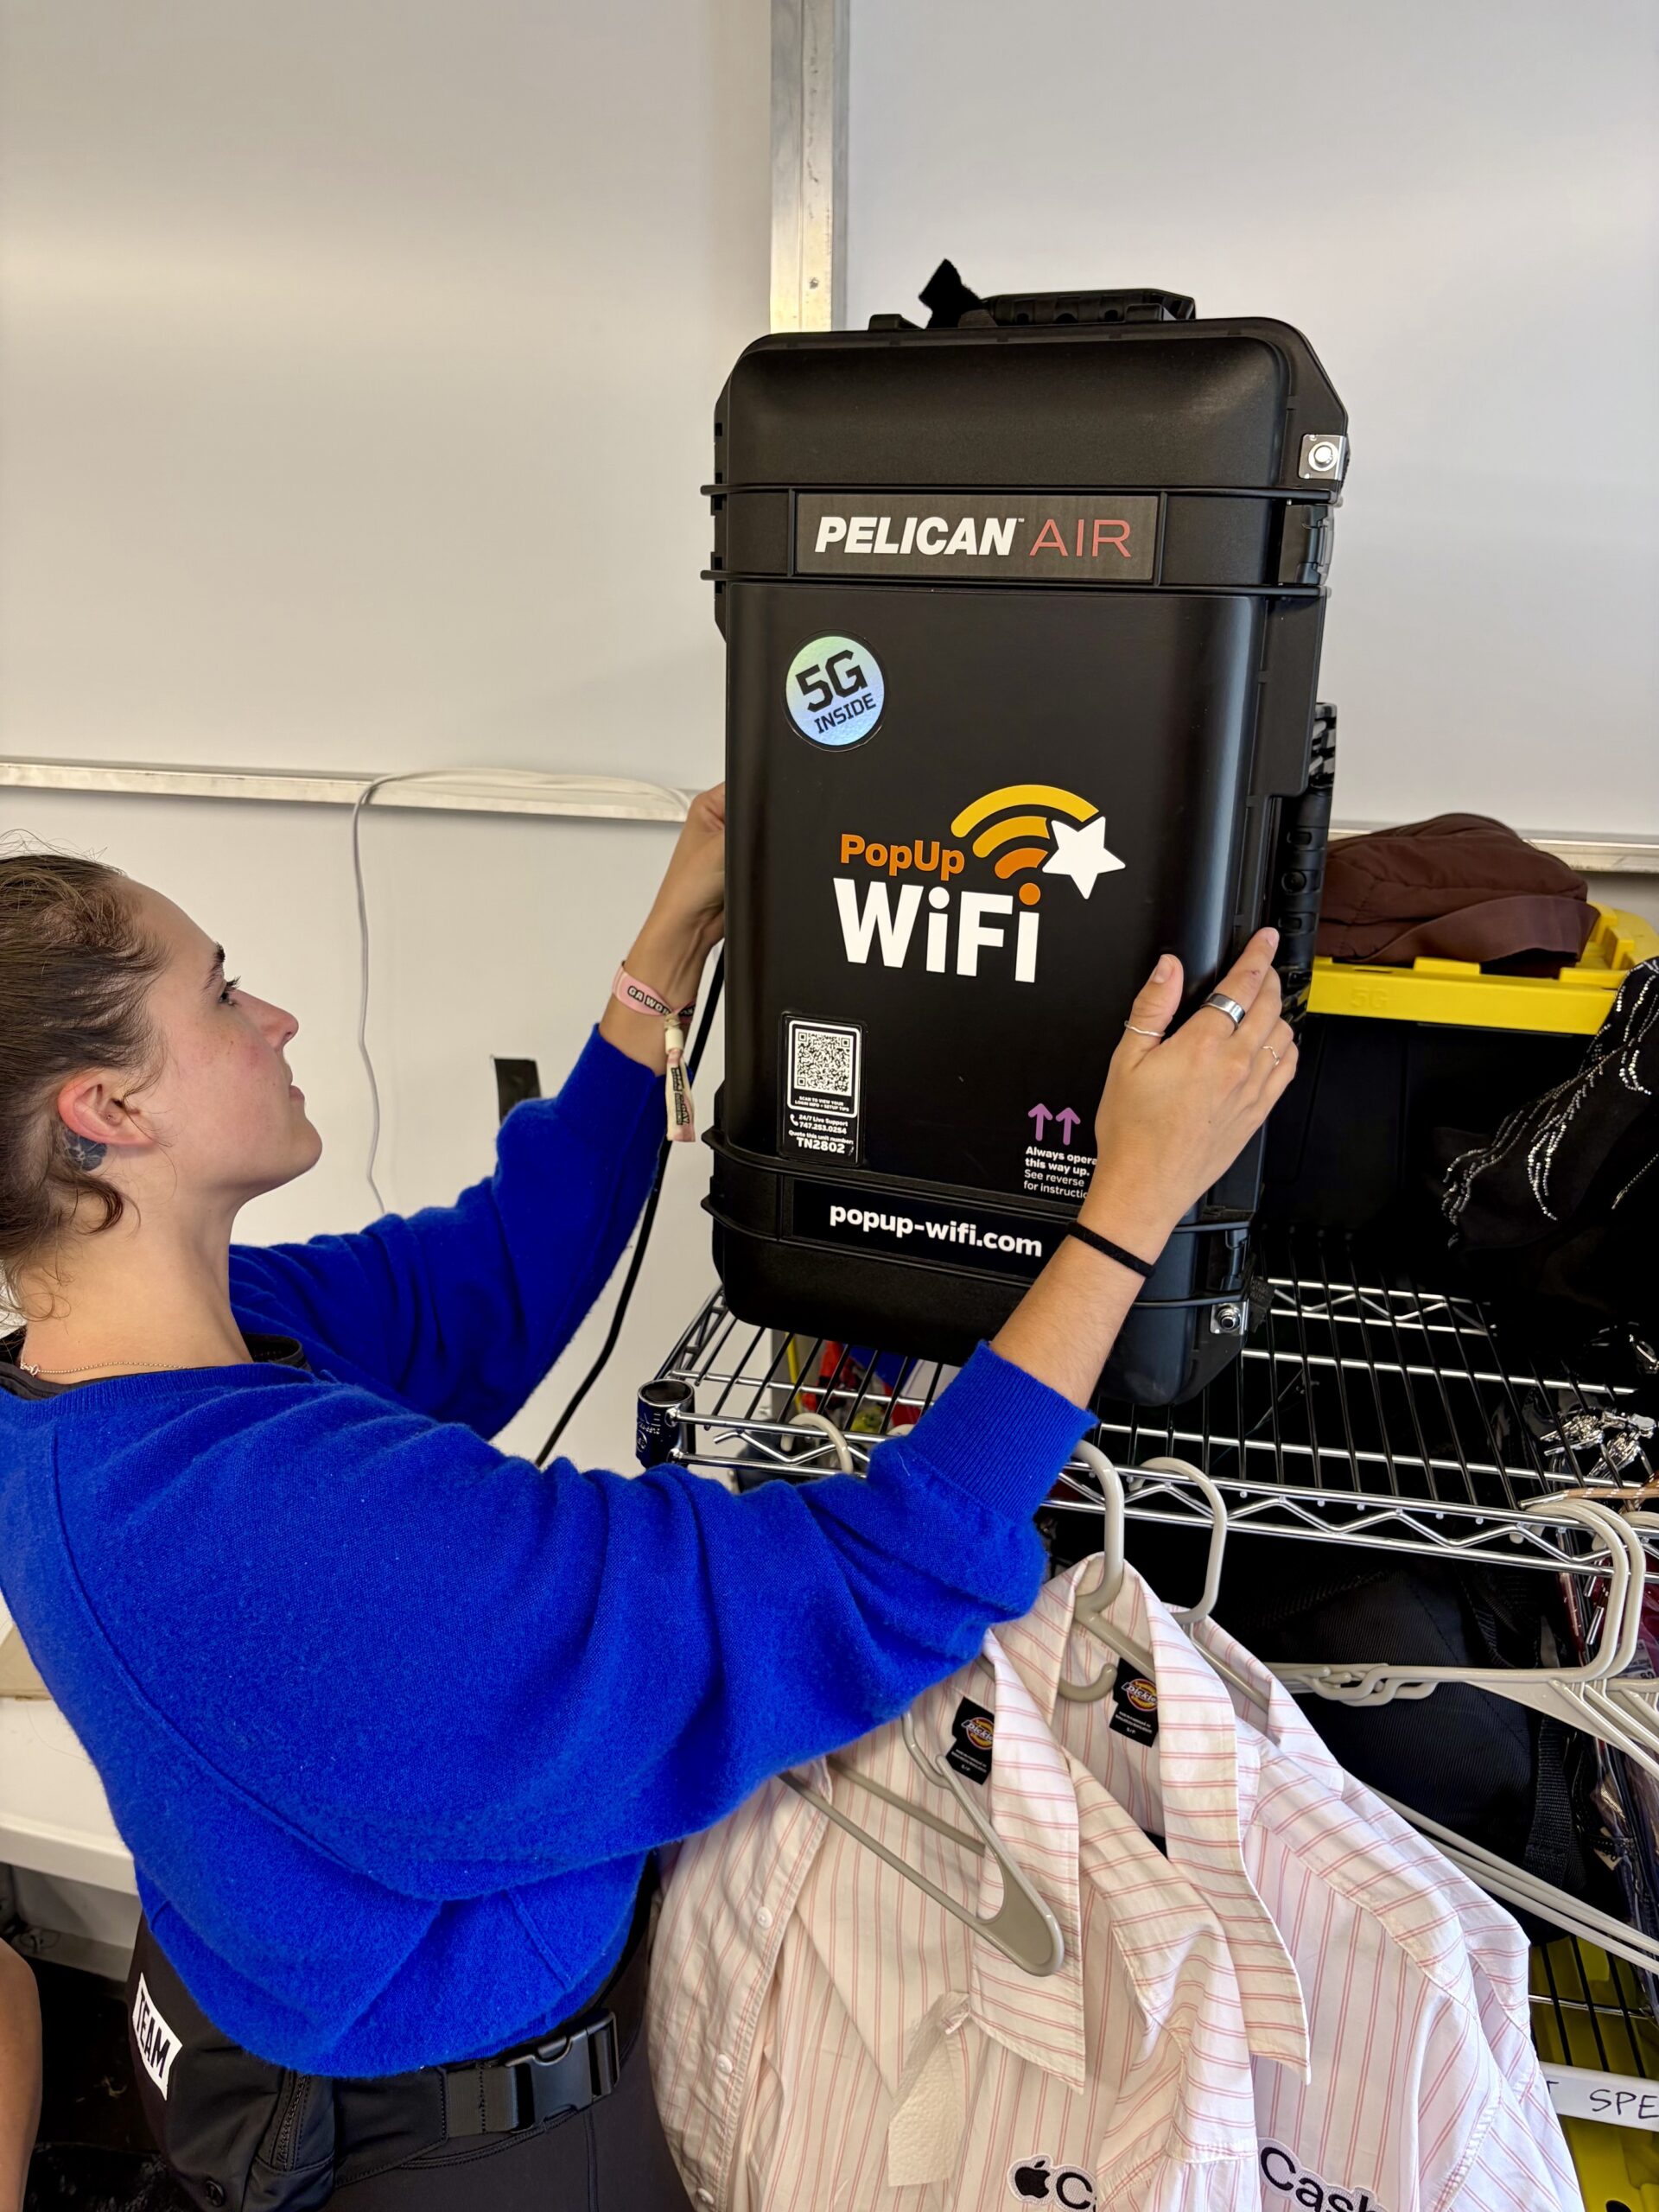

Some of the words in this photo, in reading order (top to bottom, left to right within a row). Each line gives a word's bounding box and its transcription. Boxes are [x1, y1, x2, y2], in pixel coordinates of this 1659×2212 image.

[1029, 518, 1132, 558] AIR
[795, 649, 868, 713] 5G
[813, 692, 877, 734] INSIDE
[840, 833, 965, 881] PopUp
[833, 878, 1041, 983] WiFi
[627, 985, 645, 1002] GA
[825, 1118, 848, 1127] Support
[797, 1137, 845, 1154] TN2802
[1025, 1146, 1065, 1160] Always
[1024, 1169, 1044, 1180] See
[1046, 1174, 1084, 1187] reverse
[1025, 1158, 1046, 1168] this
[1048, 1161, 1071, 1174] way
[1073, 1166, 1090, 1177] up.
[1023, 1180, 1039, 1191] for
[830, 1205, 1043, 1257] popup-wifi.com
[135, 1988, 171, 2079] TEAM
[1590, 2088, 1659, 2120] SPE
